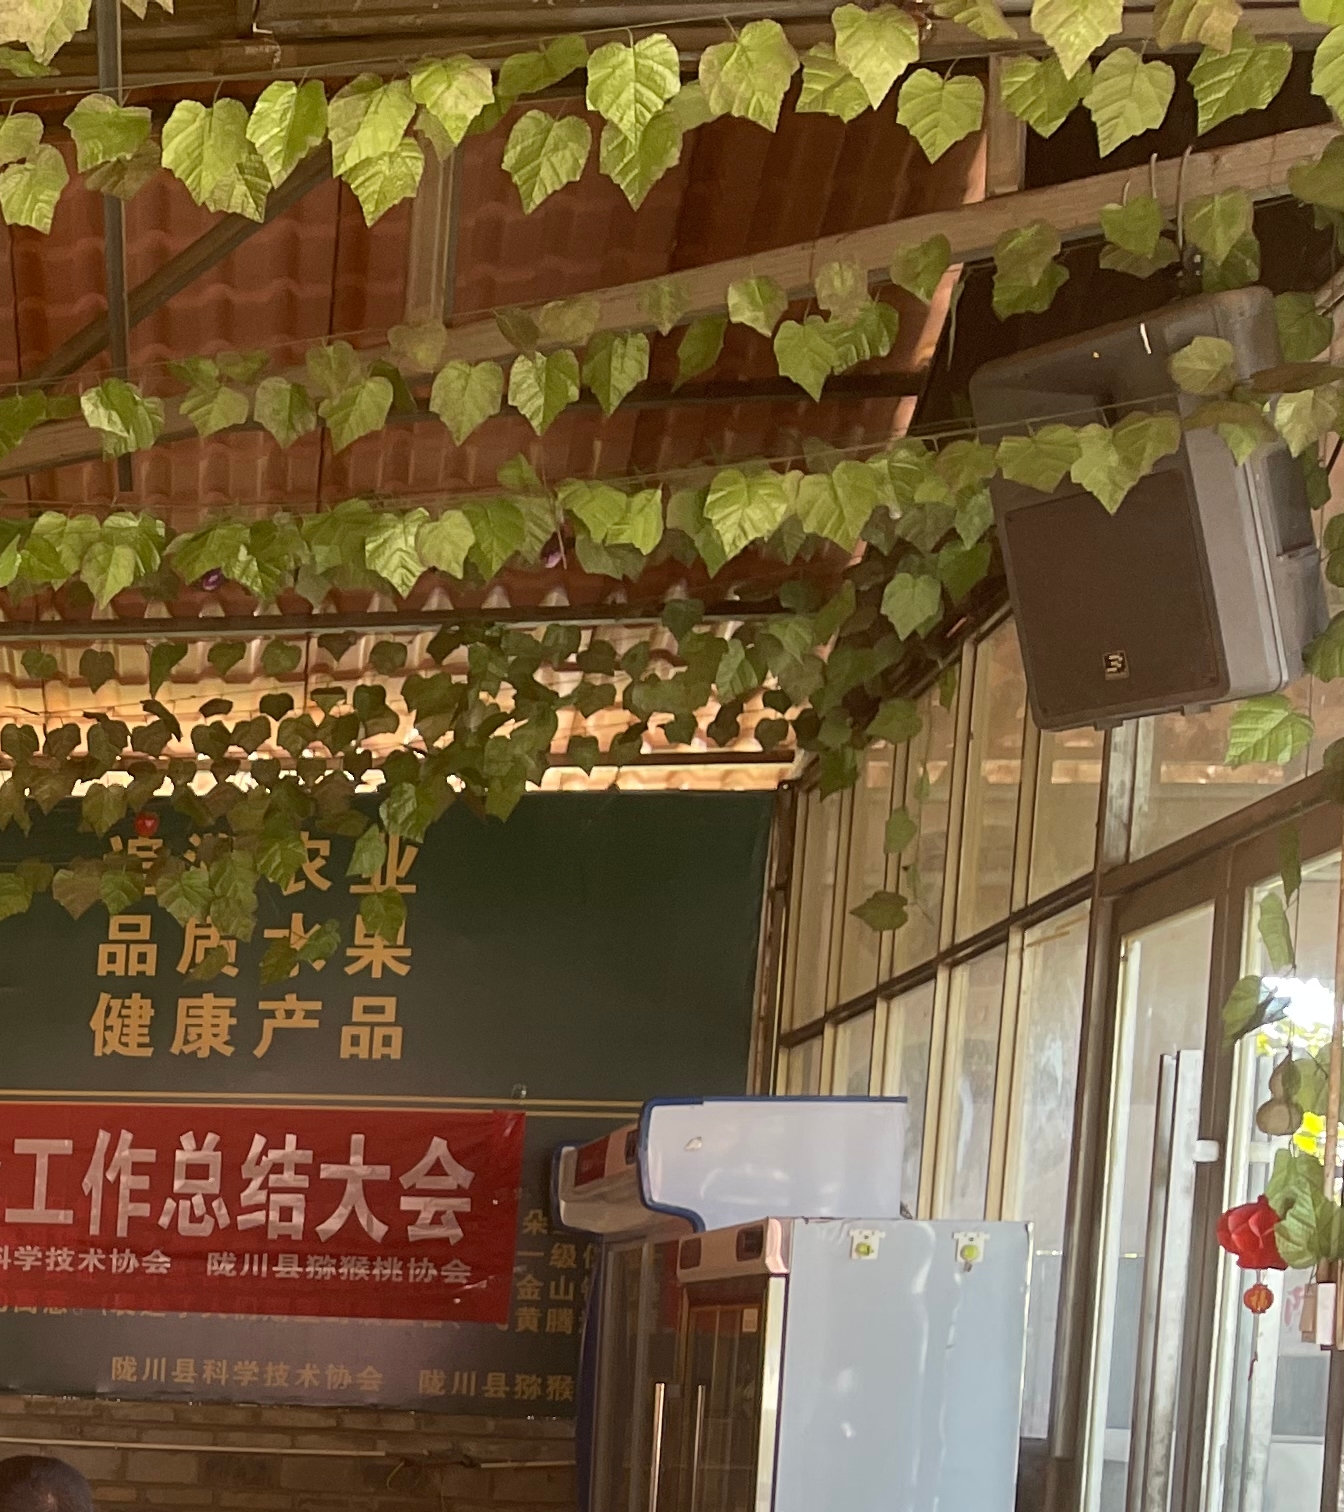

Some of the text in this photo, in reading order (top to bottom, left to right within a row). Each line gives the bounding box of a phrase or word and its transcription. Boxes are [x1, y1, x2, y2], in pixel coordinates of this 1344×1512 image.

[104, 830, 419, 896] 农业
[89, 992, 404, 1060] 健康产品
[206, 1251, 472, 1285] 陇川县猕猴桃协会
[111, 1355, 384, 1393] 陇川县科学技术协会
